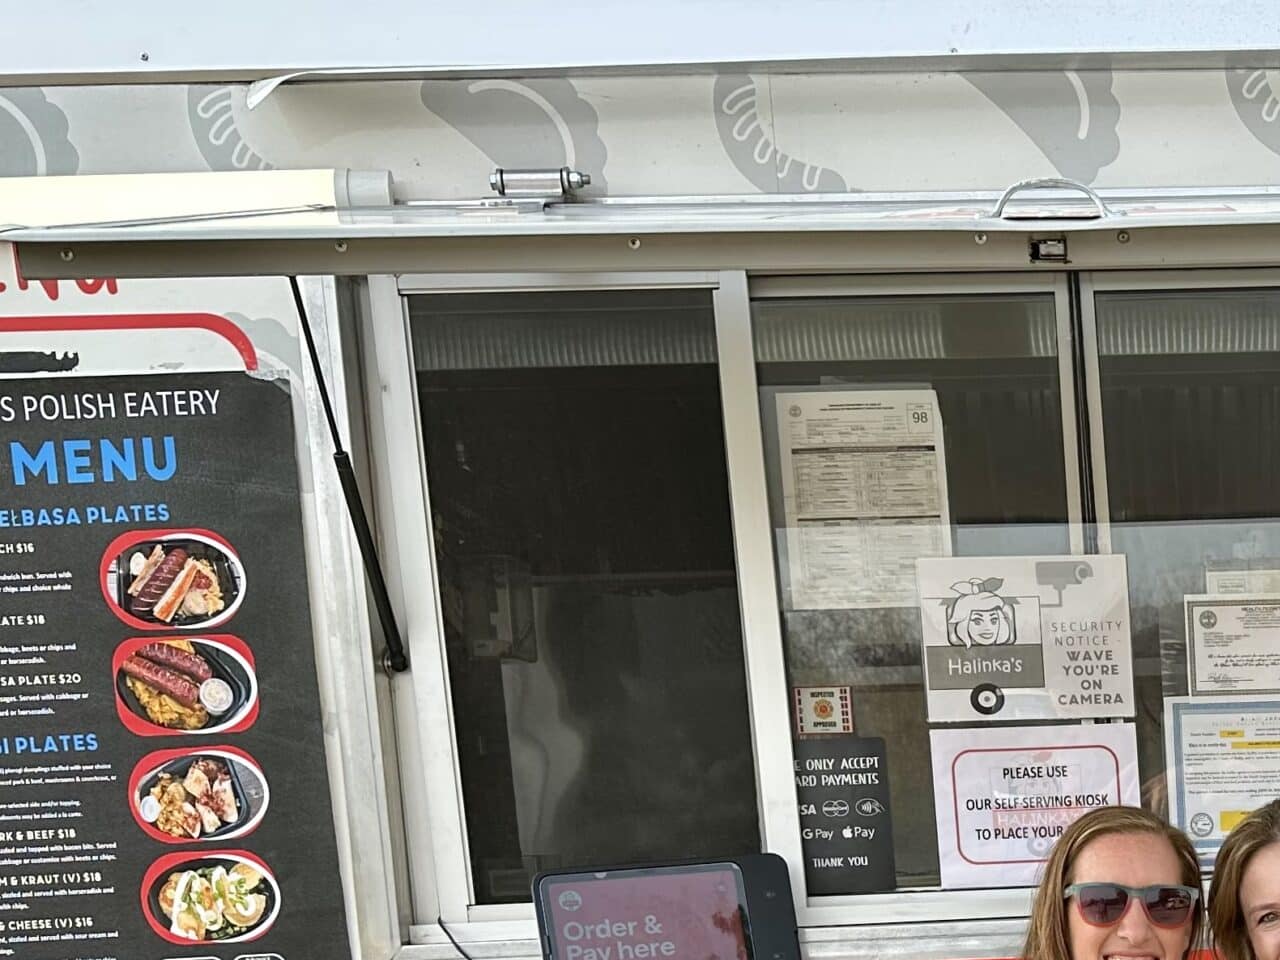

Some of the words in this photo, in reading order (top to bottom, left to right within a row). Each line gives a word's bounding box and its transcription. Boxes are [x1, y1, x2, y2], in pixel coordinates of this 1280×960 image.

[24, 394, 116, 421] POLISH
[126, 390, 221, 416] EATERY
[912, 411, 928, 423] 98
[10, 435, 178, 485] MENU
[87, 504, 170, 524] PLATES
[1050, 620, 1122, 632] SECURITY
[1054, 635, 1109, 648] NOTICE
[1066, 650, 1113, 661] WAVE
[948, 658, 1023, 676] Halinka's
[1062, 664, 1119, 676] YOU'RE
[18, 675, 56, 685] PLATE
[58, 673, 81, 684] $20
[1080, 680, 1103, 691] ON
[1058, 694, 1124, 706] CAMERA
[15, 733, 98, 753] PLATES
[806, 757, 834, 771] ONLY
[840, 756, 879, 770] ACCEPT
[1002, 766, 1043, 779] PLEASE
[1046, 765, 1068, 777] USE
[821, 773, 880, 786] PAYMENTS
[966, 798, 992, 811] OUR
[994, 795, 1072, 810] SELF-SERVING
[1075, 794, 1109, 806] KIOSK
[27, 830, 54, 840] BEEF
[815, 828, 834, 841] Pay
[975, 828, 991, 841] TO
[994, 826, 1029, 840] PLACE
[1031, 826, 1063, 838] YOUR
[812, 857, 843, 868] THANK
[848, 856, 868, 866] YOU
[21, 874, 59, 885] KRAUT
[62, 873, 80, 883] (V)
[8, 919, 52, 930] CHEESE
[55, 918, 73, 928] (V)
[563, 918, 637, 941] Order
[644, 915, 663, 935] &
[618, 941, 676, 960] here
